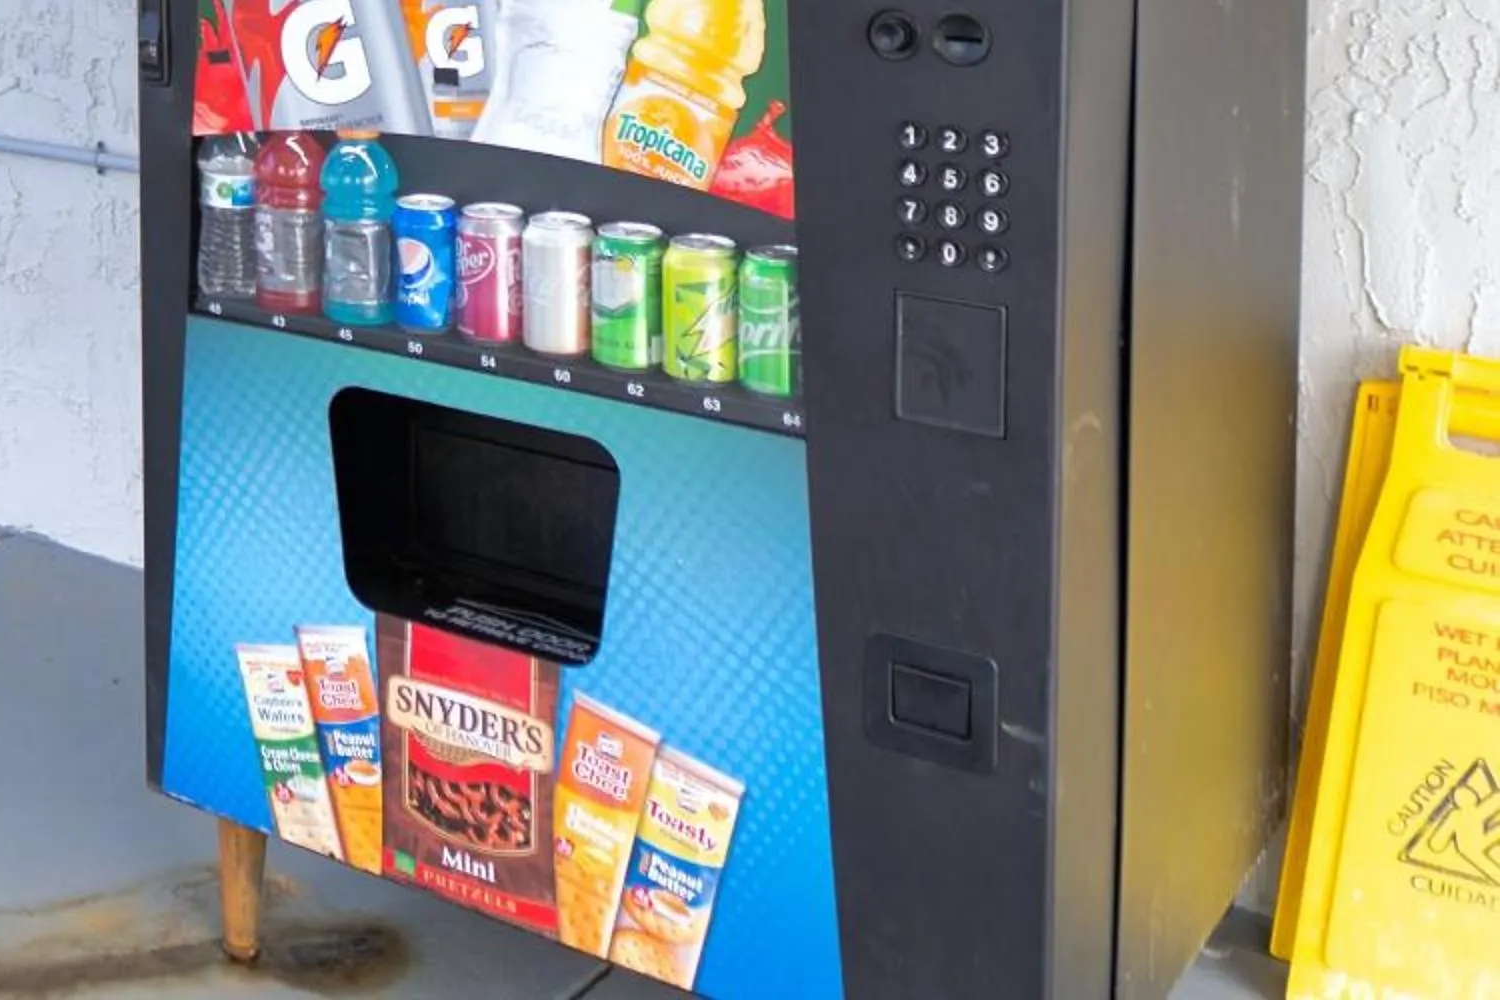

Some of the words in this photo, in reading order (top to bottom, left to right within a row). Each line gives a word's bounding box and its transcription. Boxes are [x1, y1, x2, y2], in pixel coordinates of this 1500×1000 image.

[425, 5, 485, 79] G
[615, 113, 708, 180] Tropicana
[905, 124, 916, 145] 1
[943, 131, 957, 150] 2
[984, 135, 1000, 155] 3
[903, 163, 917, 183] 4
[943, 169, 957, 190] 5
[984, 173, 1000, 195] 6
[904, 201, 917, 221] 7
[944, 206, 957, 226] 8
[983, 211, 999, 231] 9
[943, 243, 956, 264] 0
[408, 341, 423, 354] 50
[481, 355, 497, 368] 54
[554, 369, 571, 382] 60
[627, 382, 644, 396] 62
[703, 397, 721, 411] 63
[783, 412, 800, 426] 64
[1455, 509, 1500, 530] CA
[1434, 622, 1490, 647] WET
[1412, 681, 1470, 709] PISO
[257, 706, 305, 725] Wafers
[395, 684, 544, 755] SNYDER'S
[334, 729, 376, 746] Peanut
[336, 743, 374, 759] Butter
[579, 745, 629, 786] Toast
[1387, 757, 1456, 837] CAUTION
[648, 800, 717, 852] Toasty
[441, 845, 497, 884] Mini
[651, 851, 704, 893] Peanut
[422, 869, 518, 914] PRETZELS
[647, 866, 697, 902] Butter
